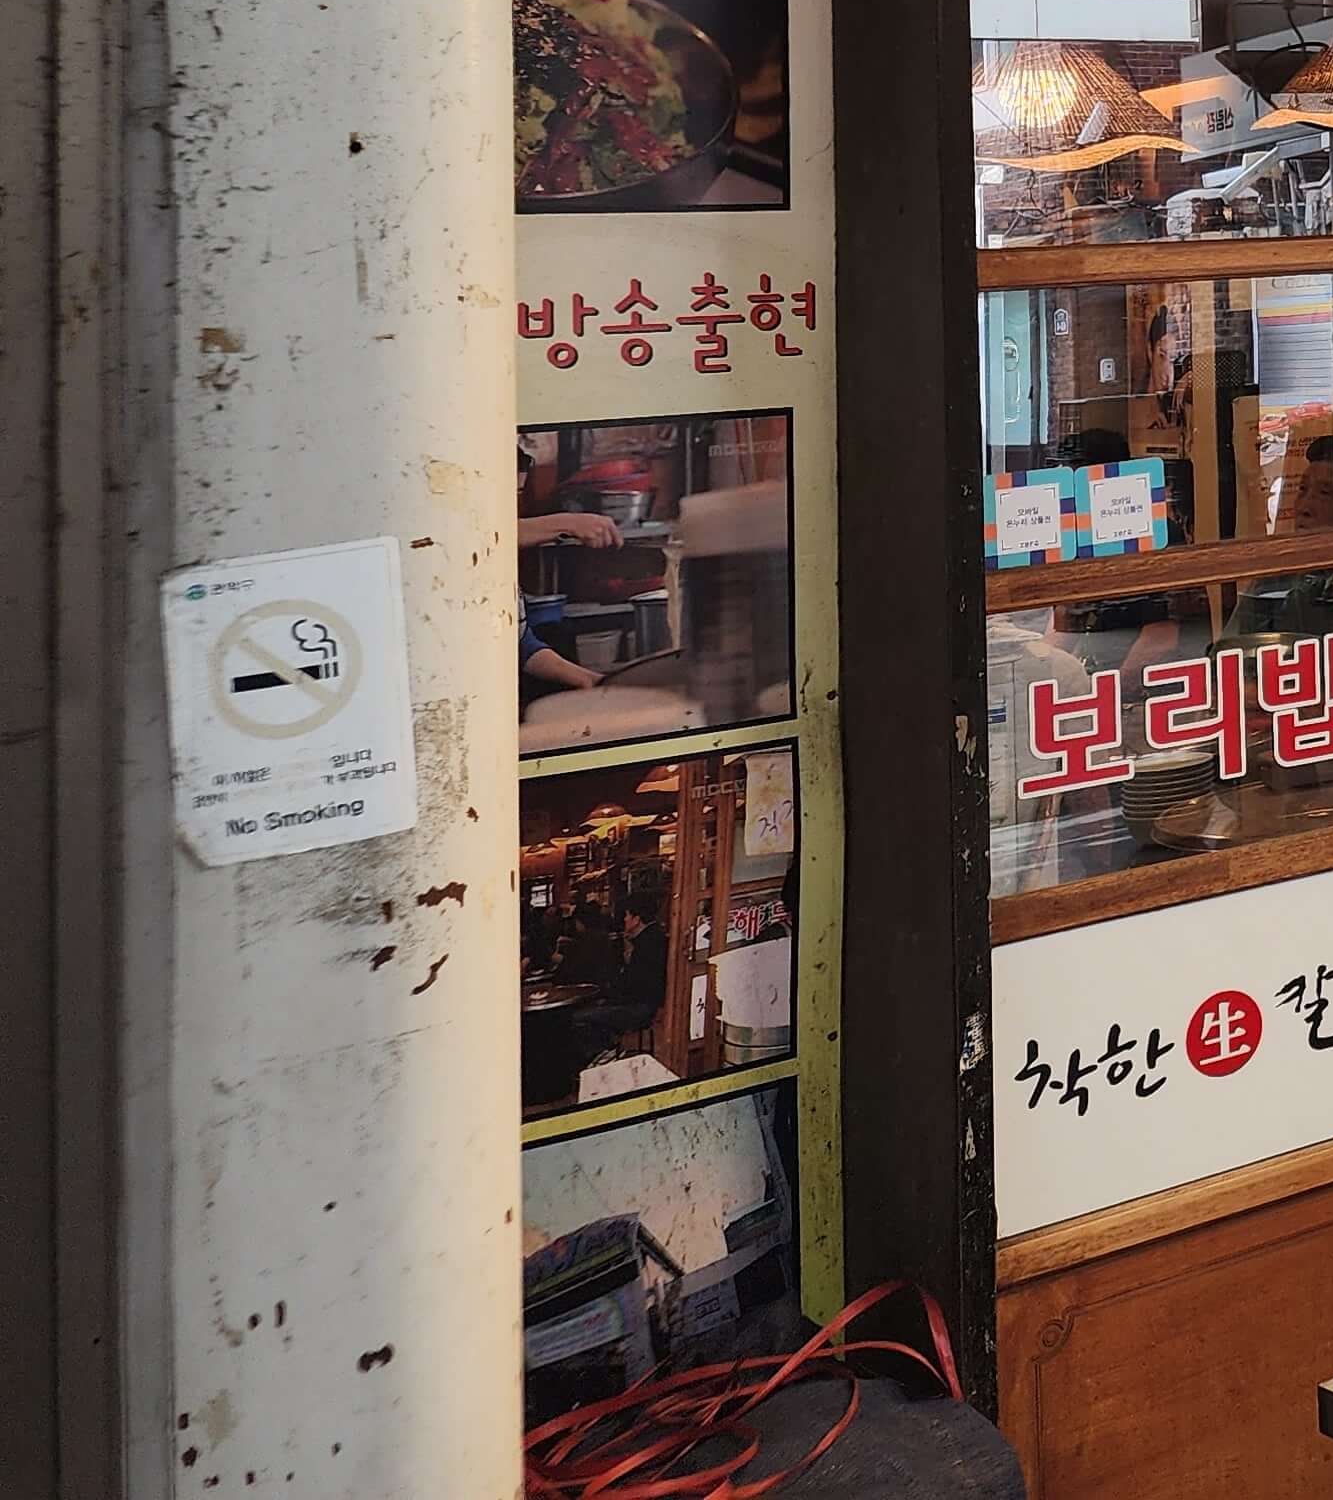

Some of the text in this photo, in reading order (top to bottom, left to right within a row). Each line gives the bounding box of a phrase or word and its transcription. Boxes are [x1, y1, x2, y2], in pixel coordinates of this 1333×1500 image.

[516, 271, 817, 375] 방송출현
[225, 816, 258, 839] No
[263, 798, 366, 832] Smoking
[1014, 1022, 1176, 1118] 착한
[1199, 1001, 1255, 1069] 生
